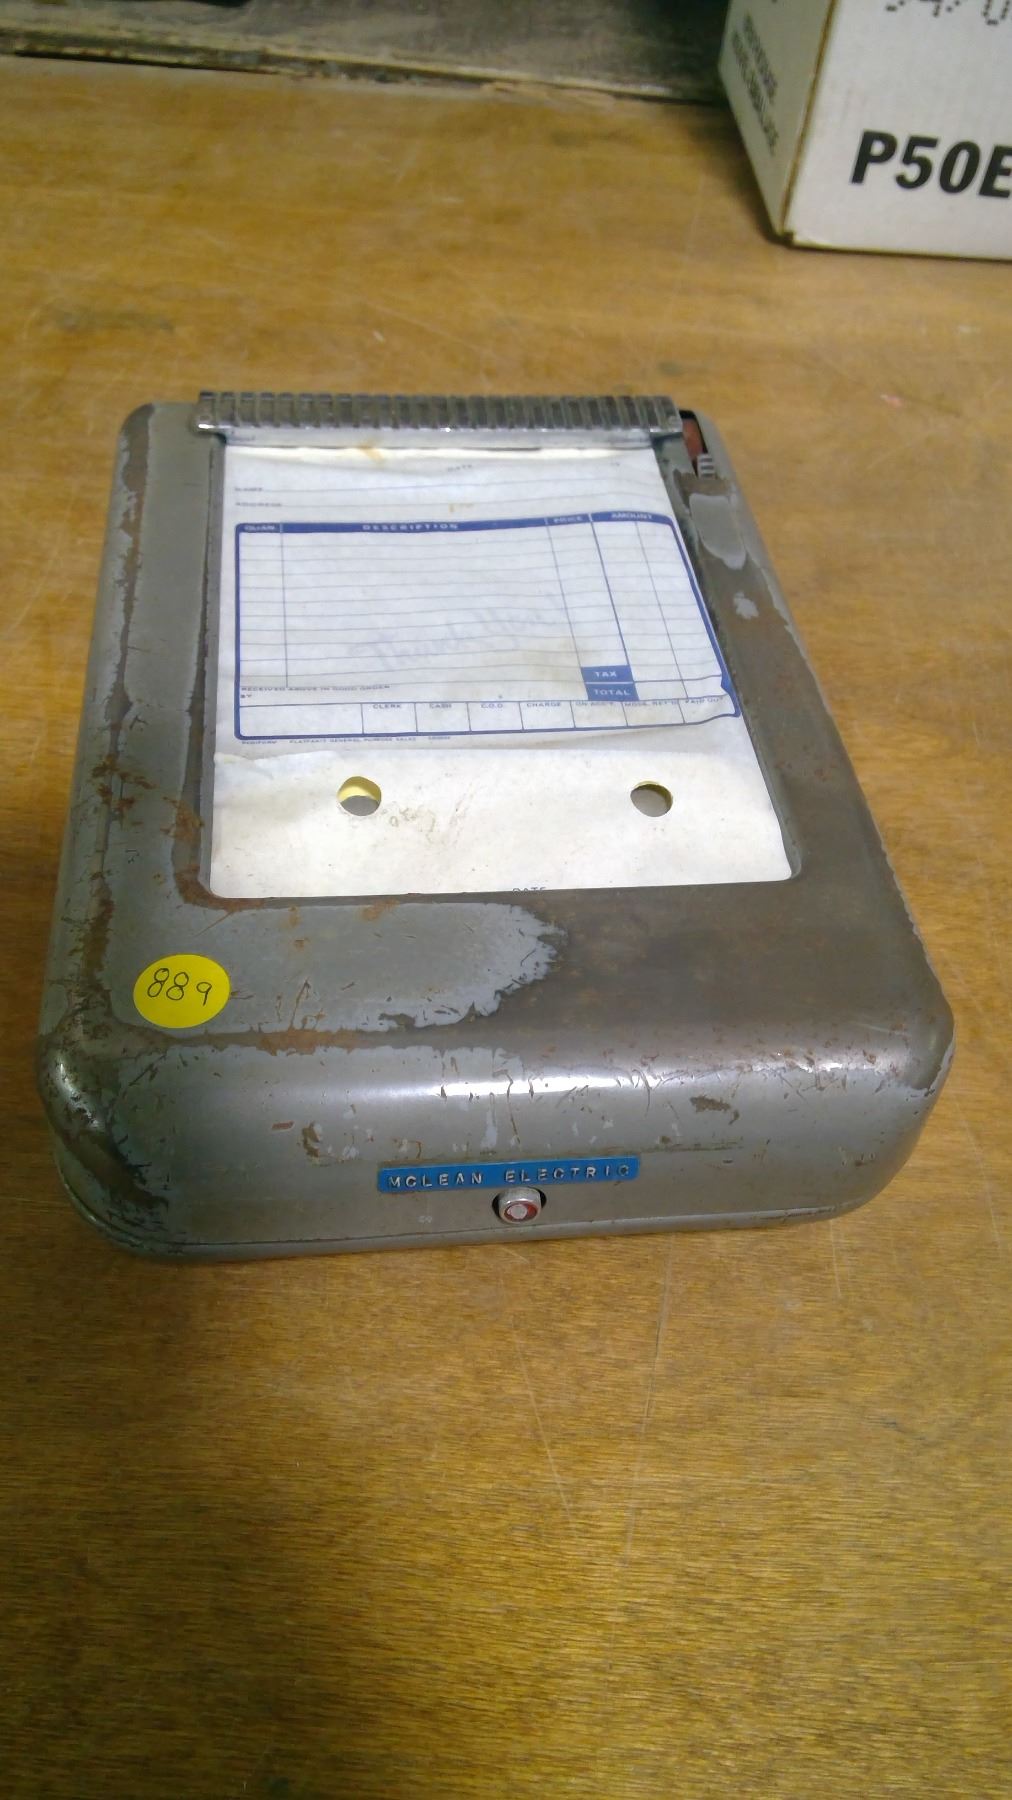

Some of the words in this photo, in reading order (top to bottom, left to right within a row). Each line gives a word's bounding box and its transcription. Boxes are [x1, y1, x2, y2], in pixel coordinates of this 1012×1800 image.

[362, 522, 460, 531] DESCRIPTION
[610, 512, 654, 521] AMOUNT
[594, 670, 617, 678] TAX
[593, 688, 631, 697] TOTAL
[147, 967, 212, 1006] 889
[388, 1172, 483, 1188] MCLEAN
[504, 1165, 629, 1183] ELECTRIC
